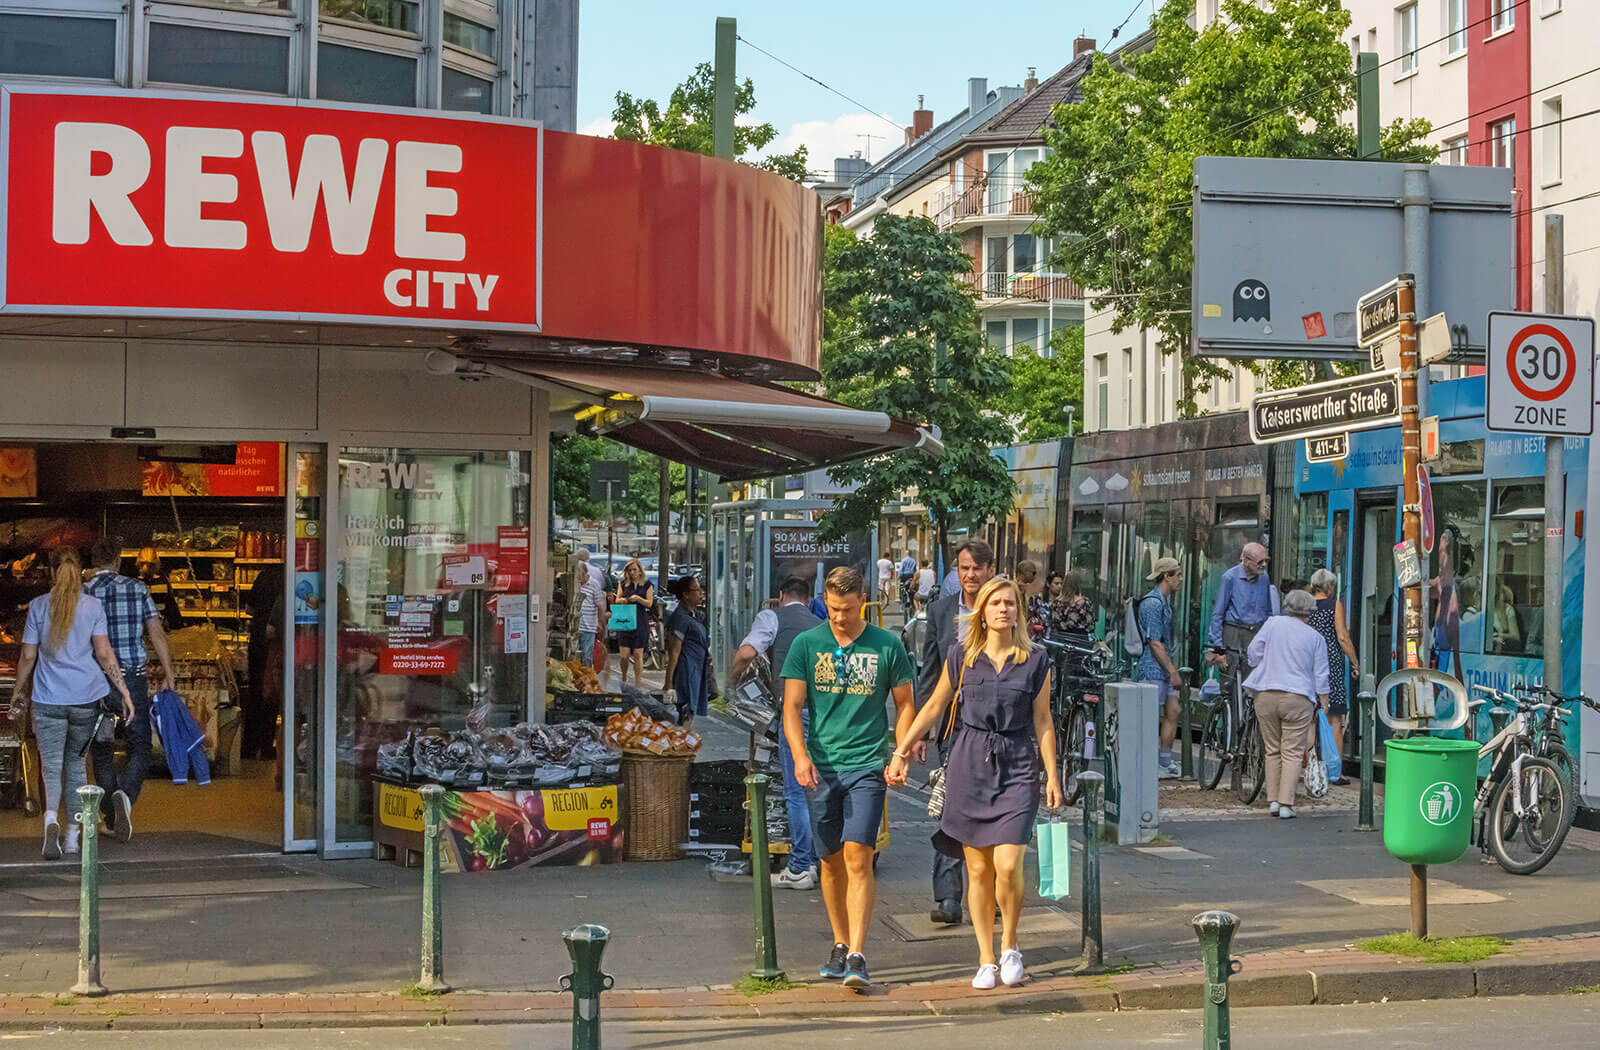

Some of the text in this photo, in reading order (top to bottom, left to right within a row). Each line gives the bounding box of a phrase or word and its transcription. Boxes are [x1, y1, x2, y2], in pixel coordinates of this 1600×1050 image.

[52, 121, 466, 262] REWE
[383, 269, 499, 312] CITY
[1521, 344, 1561, 381] 30
[1261, 388, 1388, 429] Kaiserswerther Straße
[1514, 405, 1567, 426] ZONE
[243, 446, 257, 456] Tag
[1315, 438, 1340, 456] 411-4
[1515, 440, 1521, 454] IN
[1524, 437, 1546, 454] BESTE
[218, 467, 261, 476] natürlicher
[238, 457, 266, 465] isschen
[348, 462, 435, 490] REWE
[774, 532, 788, 542] 90
[790, 532, 797, 542] %
[551, 791, 589, 812] REGION
